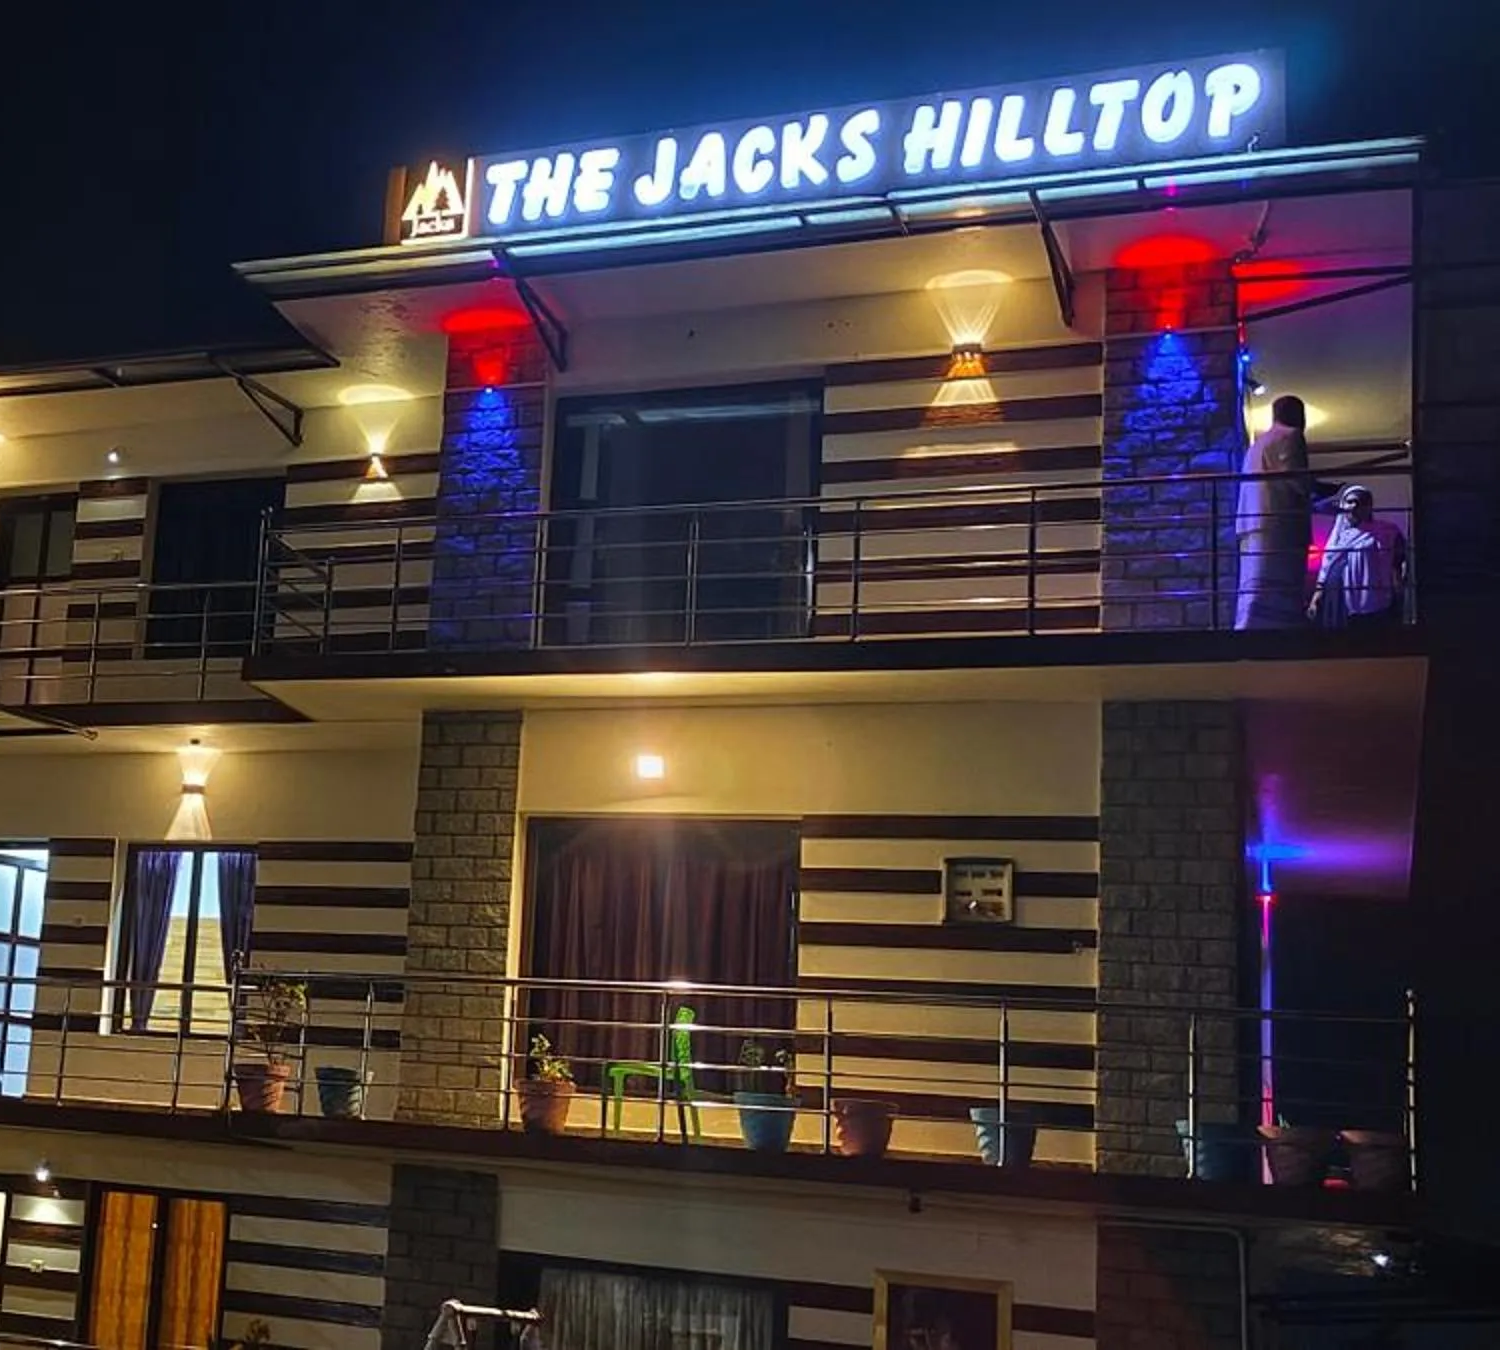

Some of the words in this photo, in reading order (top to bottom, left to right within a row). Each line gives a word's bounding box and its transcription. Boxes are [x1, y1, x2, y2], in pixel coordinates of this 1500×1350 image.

[485, 148, 620, 225] THE
[633, 108, 881, 206] JACKS
[903, 63, 1261, 175] HILLTOP
[410, 213, 456, 238] Jacks
